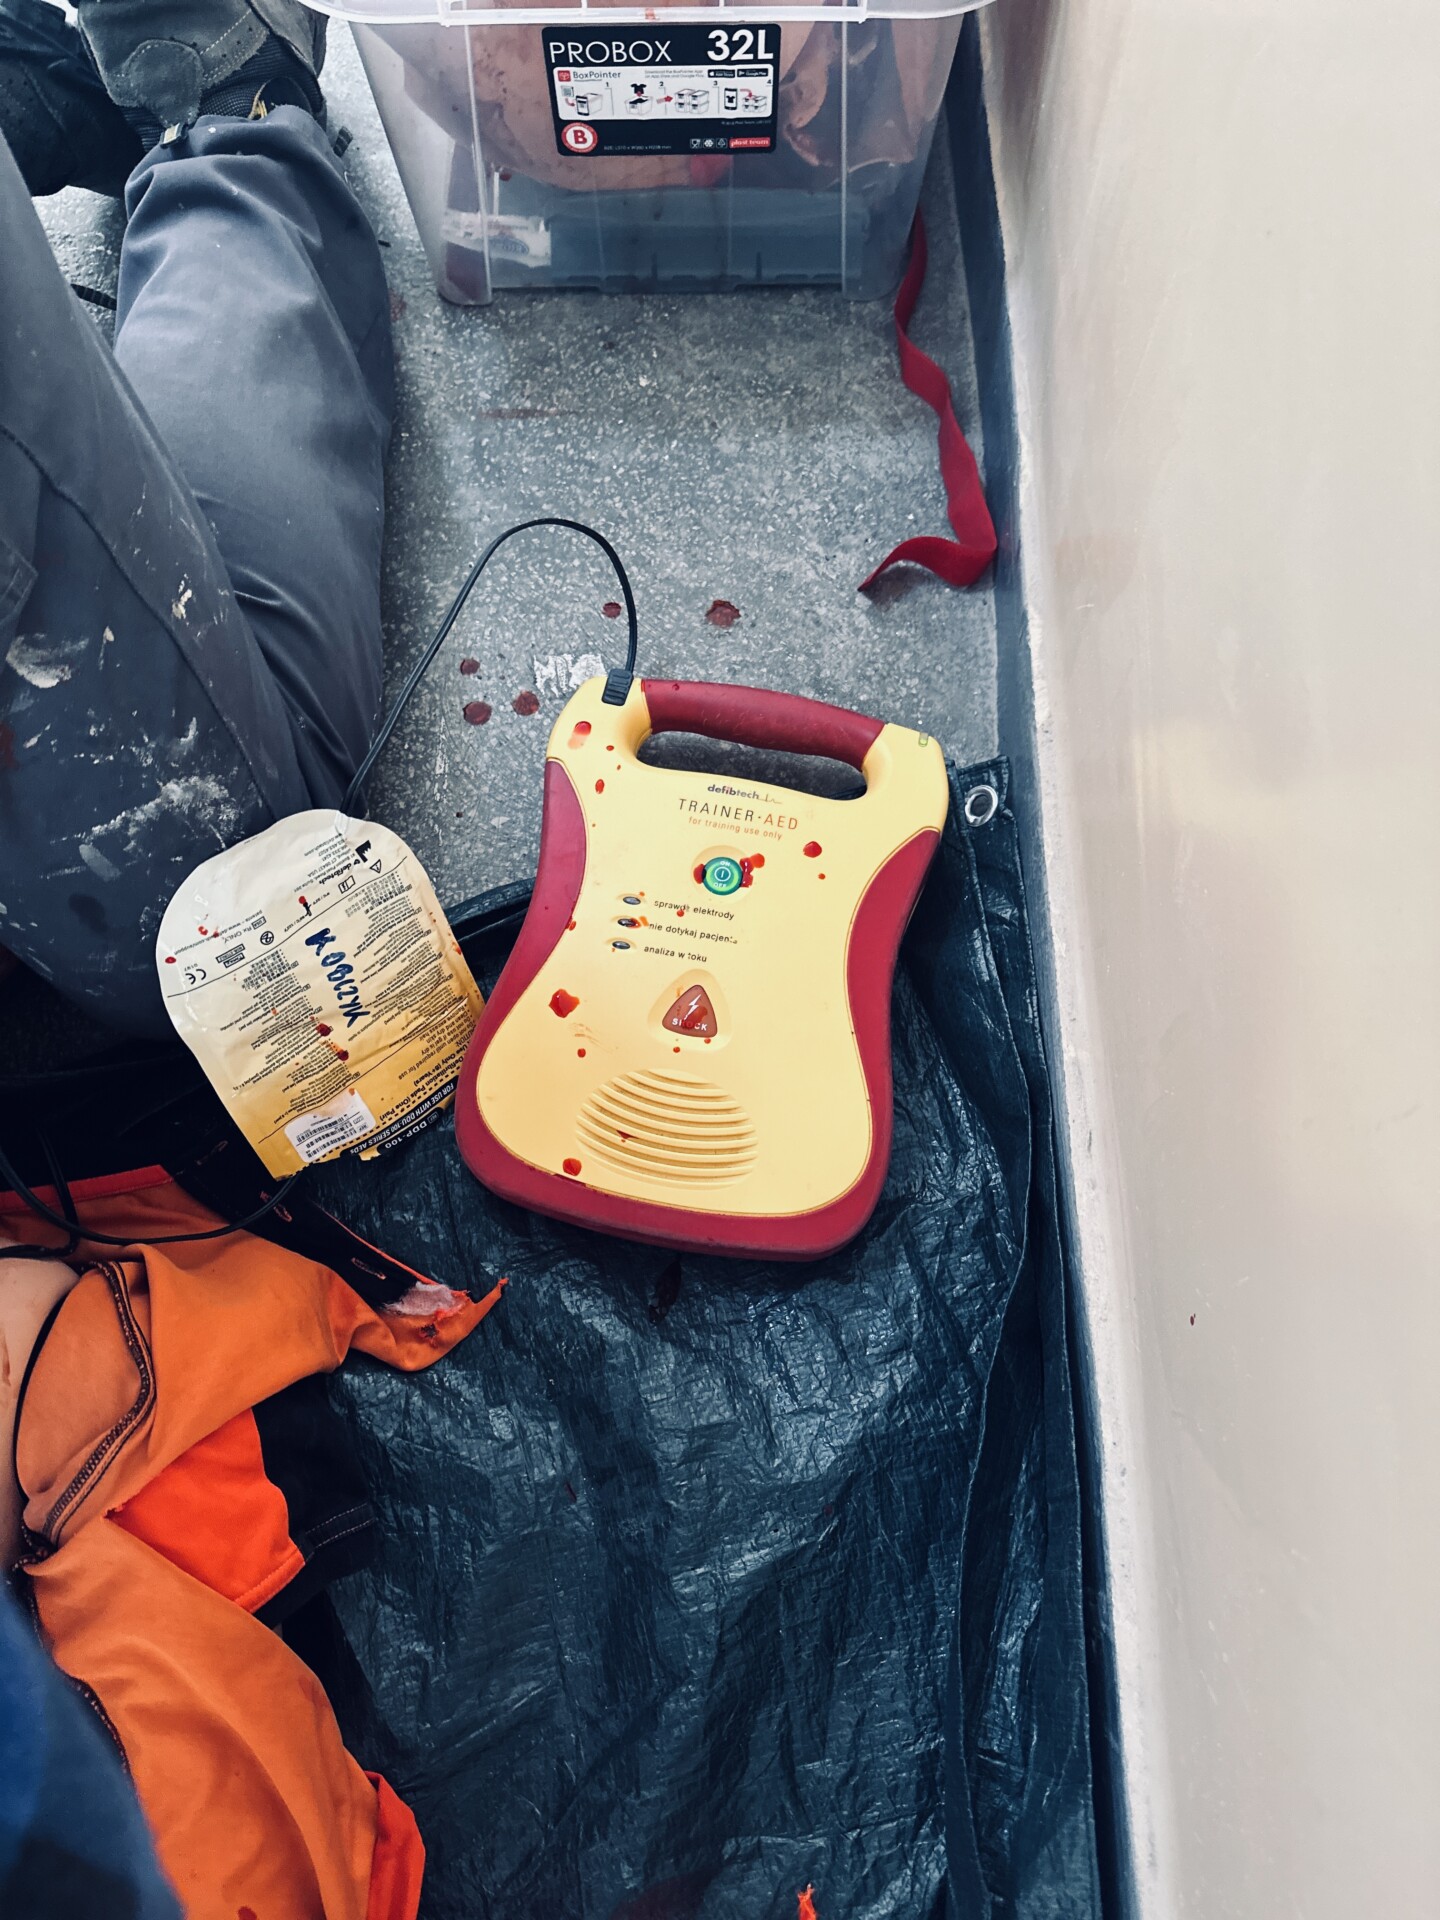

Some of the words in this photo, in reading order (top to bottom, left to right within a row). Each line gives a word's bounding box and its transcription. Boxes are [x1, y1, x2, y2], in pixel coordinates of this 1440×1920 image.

[549, 40, 672, 64] PROBOX
[706, 29, 774, 62] 32L
[572, 70, 621, 79] BoxPointer
[573, 129, 588, 145] B
[730, 138, 748, 147] plast
[749, 138, 769, 146] team
[707, 784, 759, 800] defibtech
[688, 816, 701, 825] for
[705, 818, 740, 834] training
[743, 826, 759, 836] use
[762, 829, 783, 841] only
[307, 869, 318, 878] USA
[318, 862, 352, 886] defibtech
[693, 907, 734, 920] elektrody
[222, 930, 242, 944] ONLY
[648, 922, 663, 931] nie
[665, 923, 697, 938] dotykaj
[644, 945, 675, 957] analiza
[687, 952, 708, 963] toku
[445, 1005, 465, 1021] Remove
[454, 1010, 468, 1023] Clean
[462, 1016, 471, 1024] Do
[428, 1019, 447, 1034] excess
[436, 1027, 447, 1037] dry
[445, 1021, 456, 1031] and
[446, 1028, 457, 1037] use
[455, 1022, 465, 1030] not
[458, 1027, 468, 1035] not
[418, 1031, 430, 1041] hair
[425, 1034, 437, 1044] skin
[433, 1037, 443, 1046] gel
[446, 1032, 460, 1045] open
[419, 1046, 430, 1056] dry
[435, 1042, 447, 1053] until
[454, 1043, 468, 1055] Use
[415, 1049, 437, 1068] required
[440, 1052, 456, 1066] Only
[397, 1070, 408, 1080] use
[407, 1064, 416, 1073] for
[424, 1055, 464, 1087] Defibrillation
[409, 1084, 426, 1098] Pads
[440, 1082, 455, 1096] FOR
[394, 1096, 411, 1110] (One
[429, 1091, 444, 1104] USE
[378, 1107, 395, 1121] Pair)
[413, 1100, 432, 1116] WITH
[389, 1112, 416, 1132] DDU-100
[366, 1128, 391, 1146] SERIES
[383, 1120, 427, 1149] DDP-100
[349, 1141, 368, 1155] AEDs
